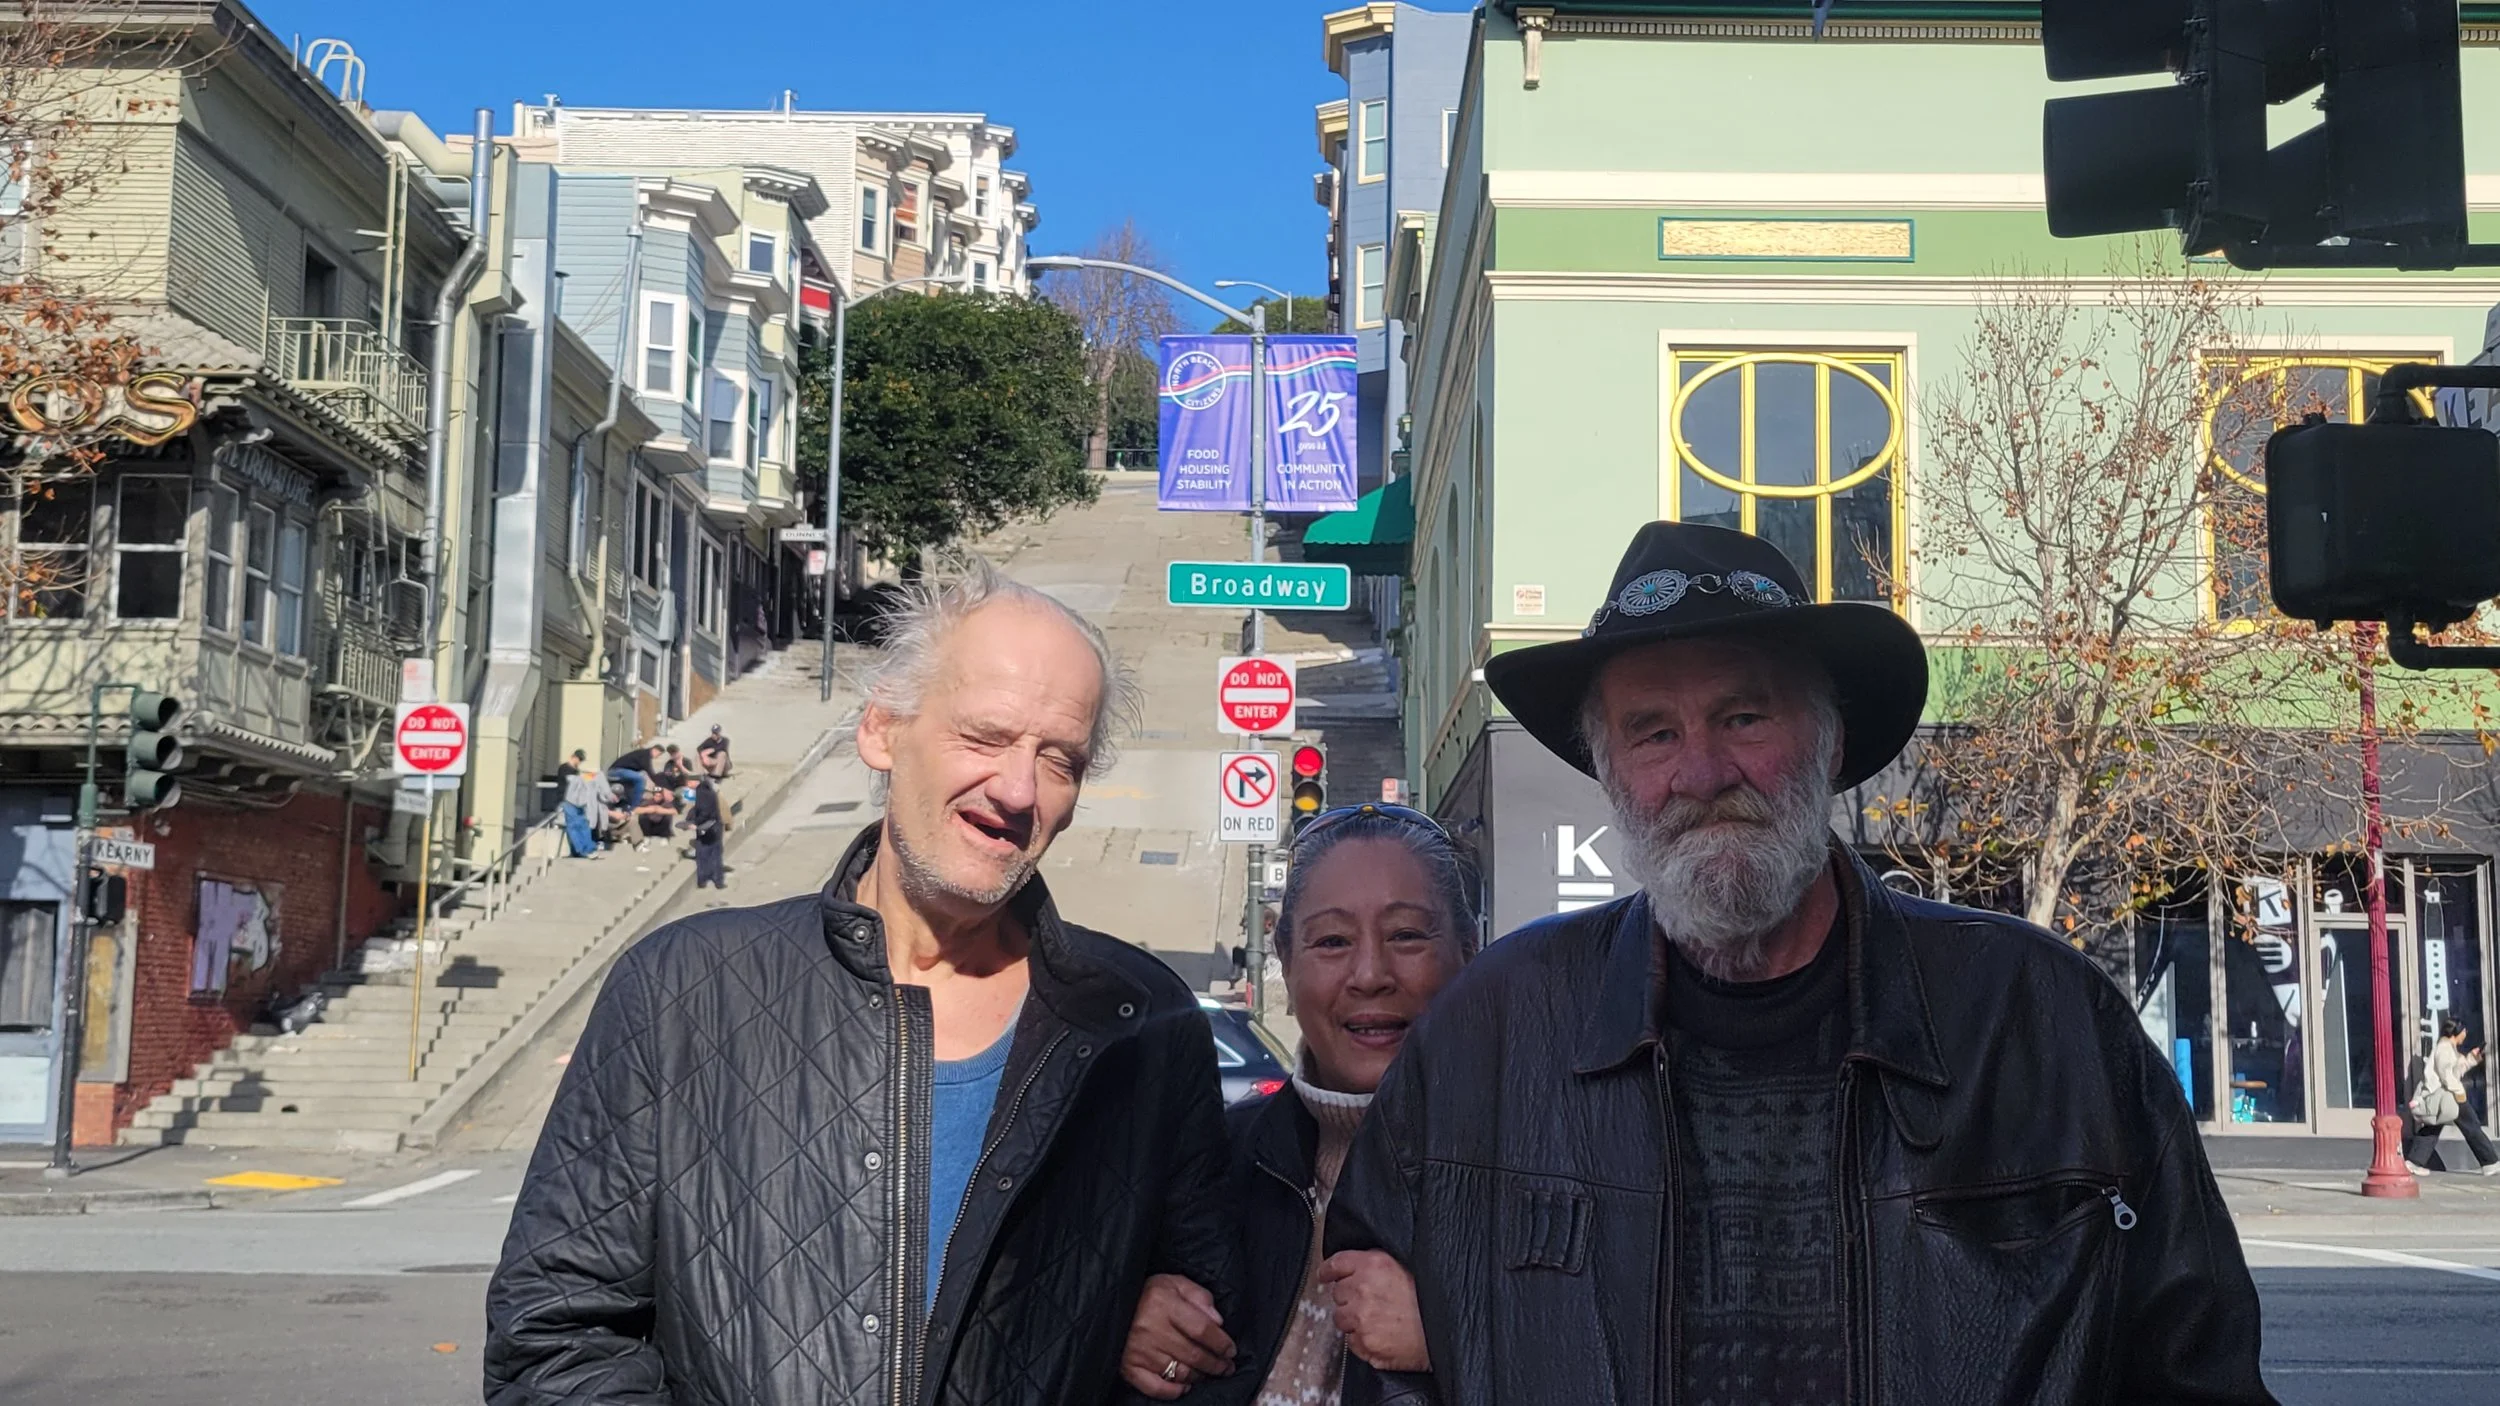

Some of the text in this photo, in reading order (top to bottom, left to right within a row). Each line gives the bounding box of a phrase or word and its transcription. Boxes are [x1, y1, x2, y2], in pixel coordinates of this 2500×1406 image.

[1171, 355, 1218, 387] NORTH BEACH
[1184, 387, 1221, 407] CITIZENS
[1278, 390, 1348, 437] 25
[1187, 449, 1220, 460] FOOD
[1179, 464, 1230, 475] HOUSING
[1276, 463, 1346, 474] COMMUNITY
[1176, 479, 1232, 490] STABILITY
[1284, 480, 1342, 490] IN ACTION
[1191, 573, 1326, 604] Broadway
[1229, 672, 1284, 686] DO NOT
[1234, 705, 1278, 719] ENTER
[407, 716, 458, 730] DO NOT
[409, 747, 451, 761] ENTER
[1223, 816, 1275, 831] ON RED
[95, 843, 151, 864] KEARNY
